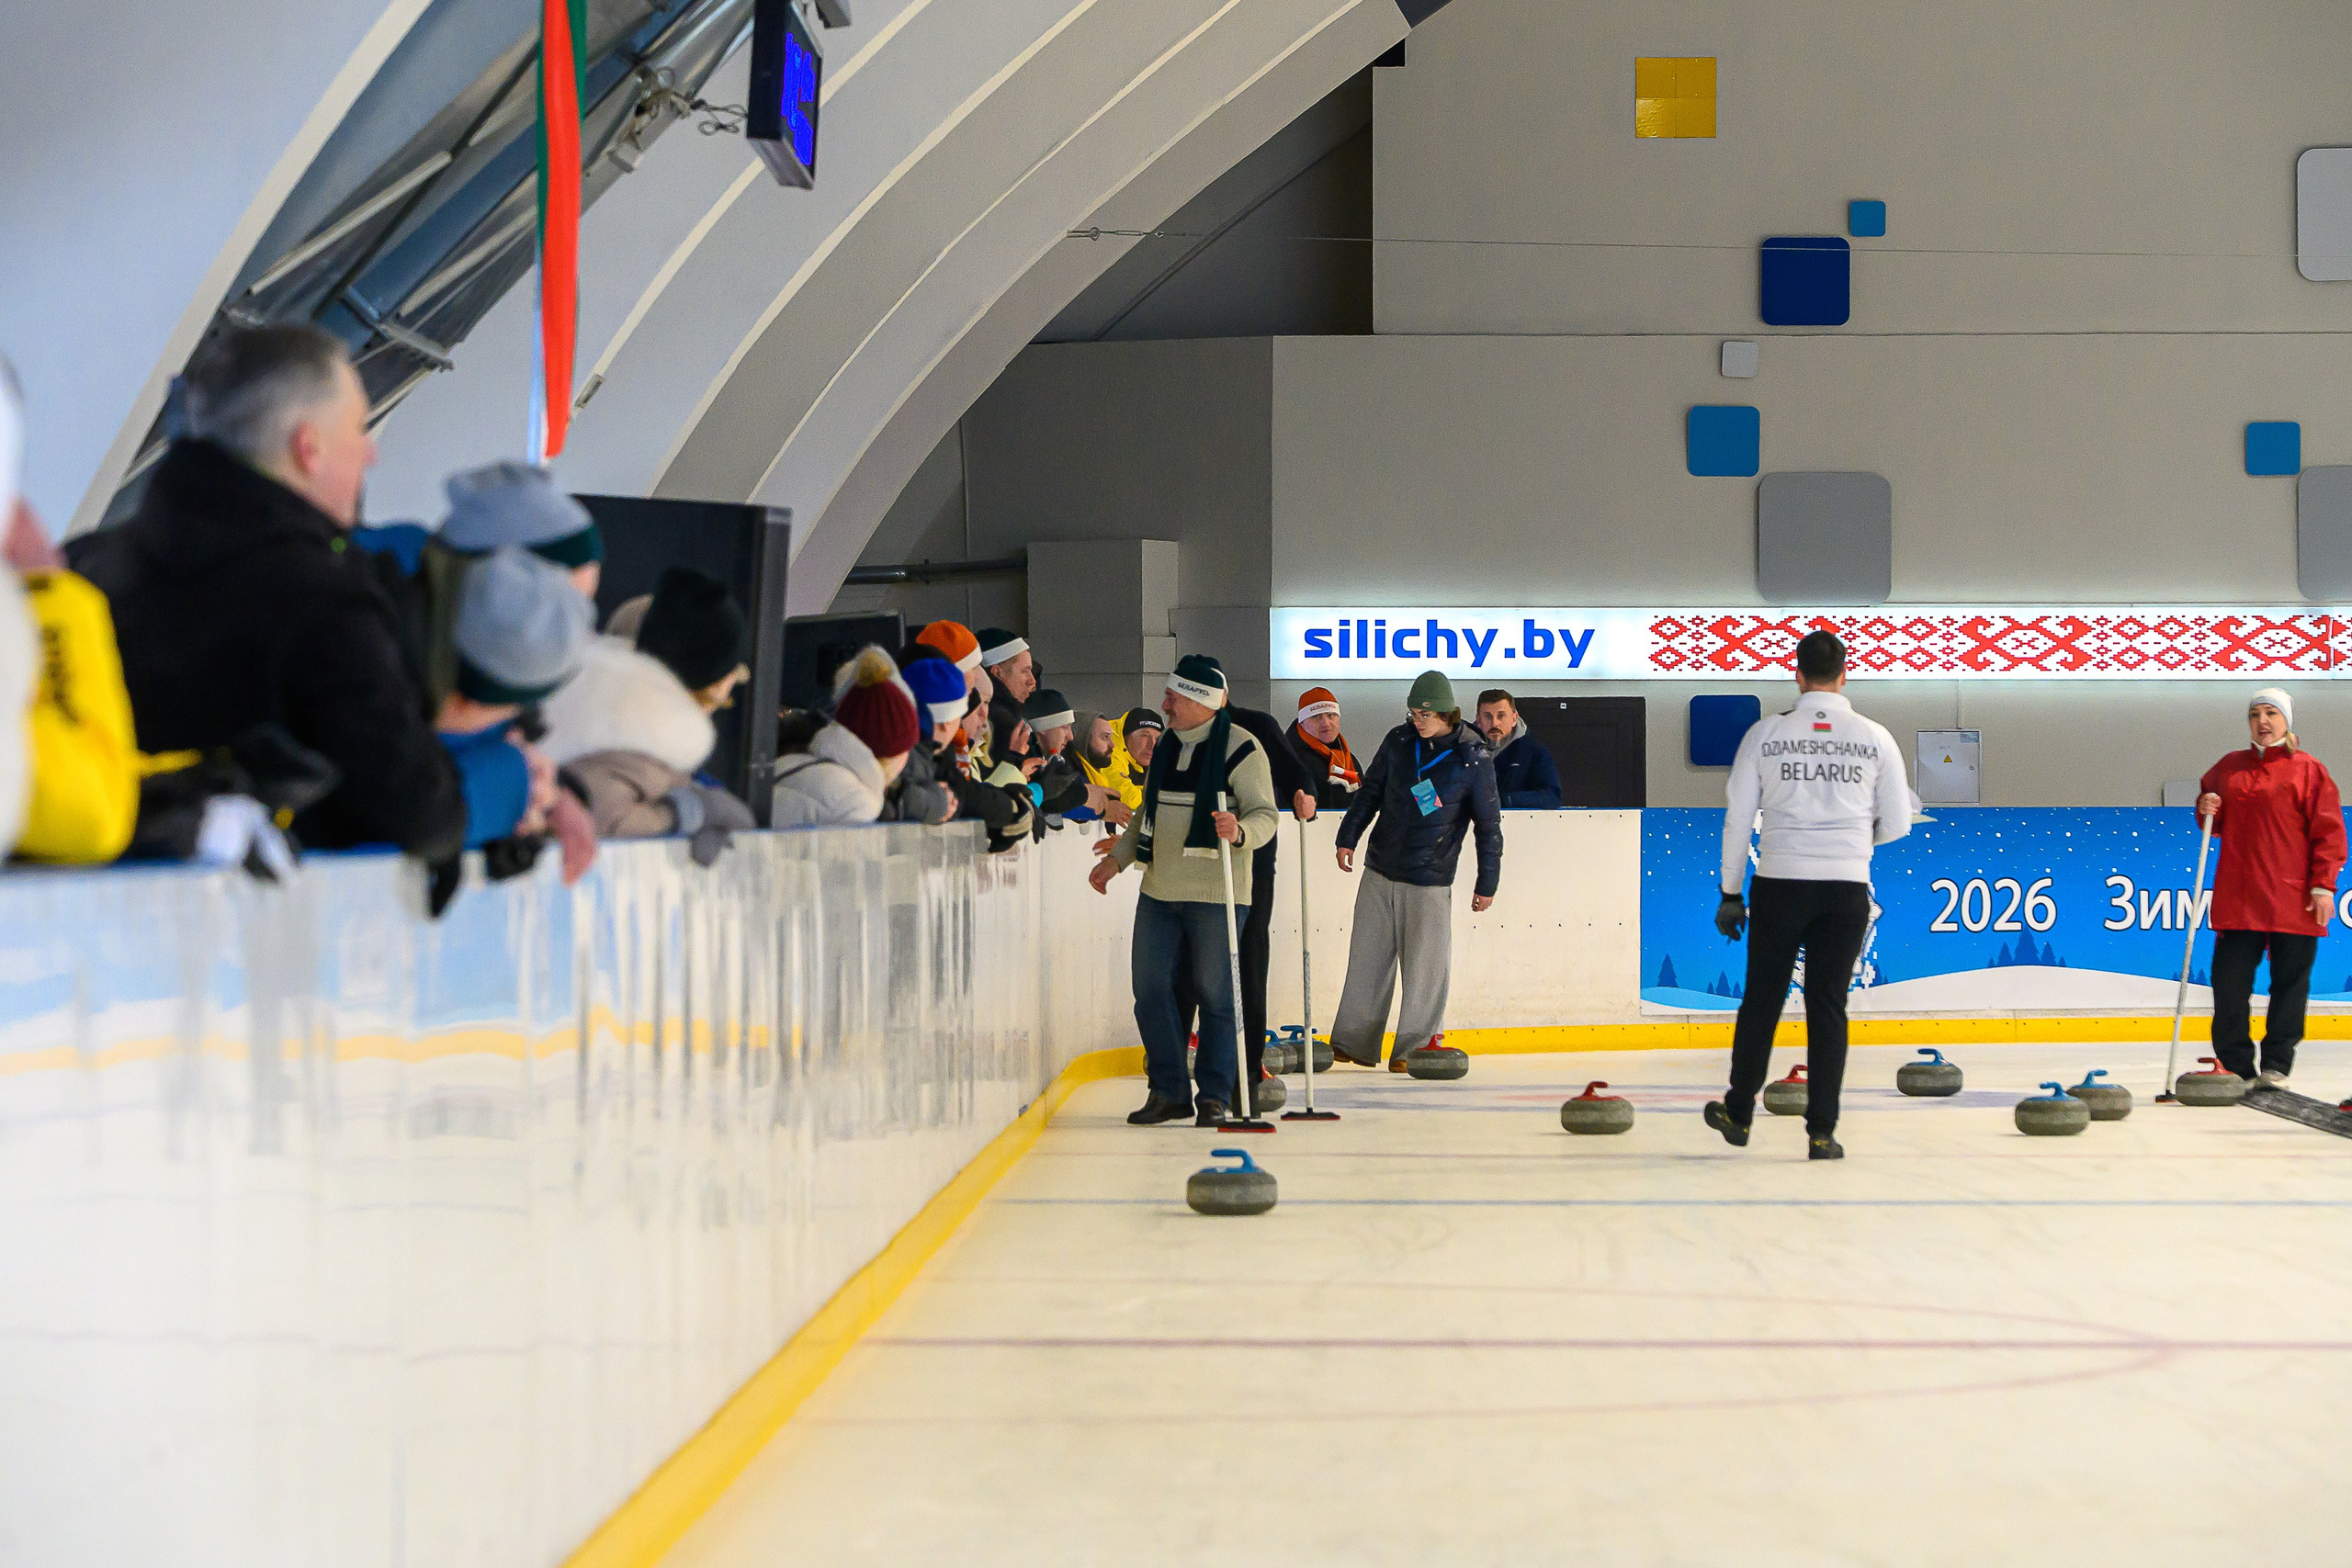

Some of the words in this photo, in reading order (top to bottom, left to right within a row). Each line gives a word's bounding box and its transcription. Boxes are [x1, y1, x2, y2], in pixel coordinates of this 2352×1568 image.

[1304, 619, 1595, 668] silichy.by
[1781, 761, 1863, 784] BELARUS
[1930, 876, 2058, 932] 2026
[2104, 874, 2214, 931] Зим
